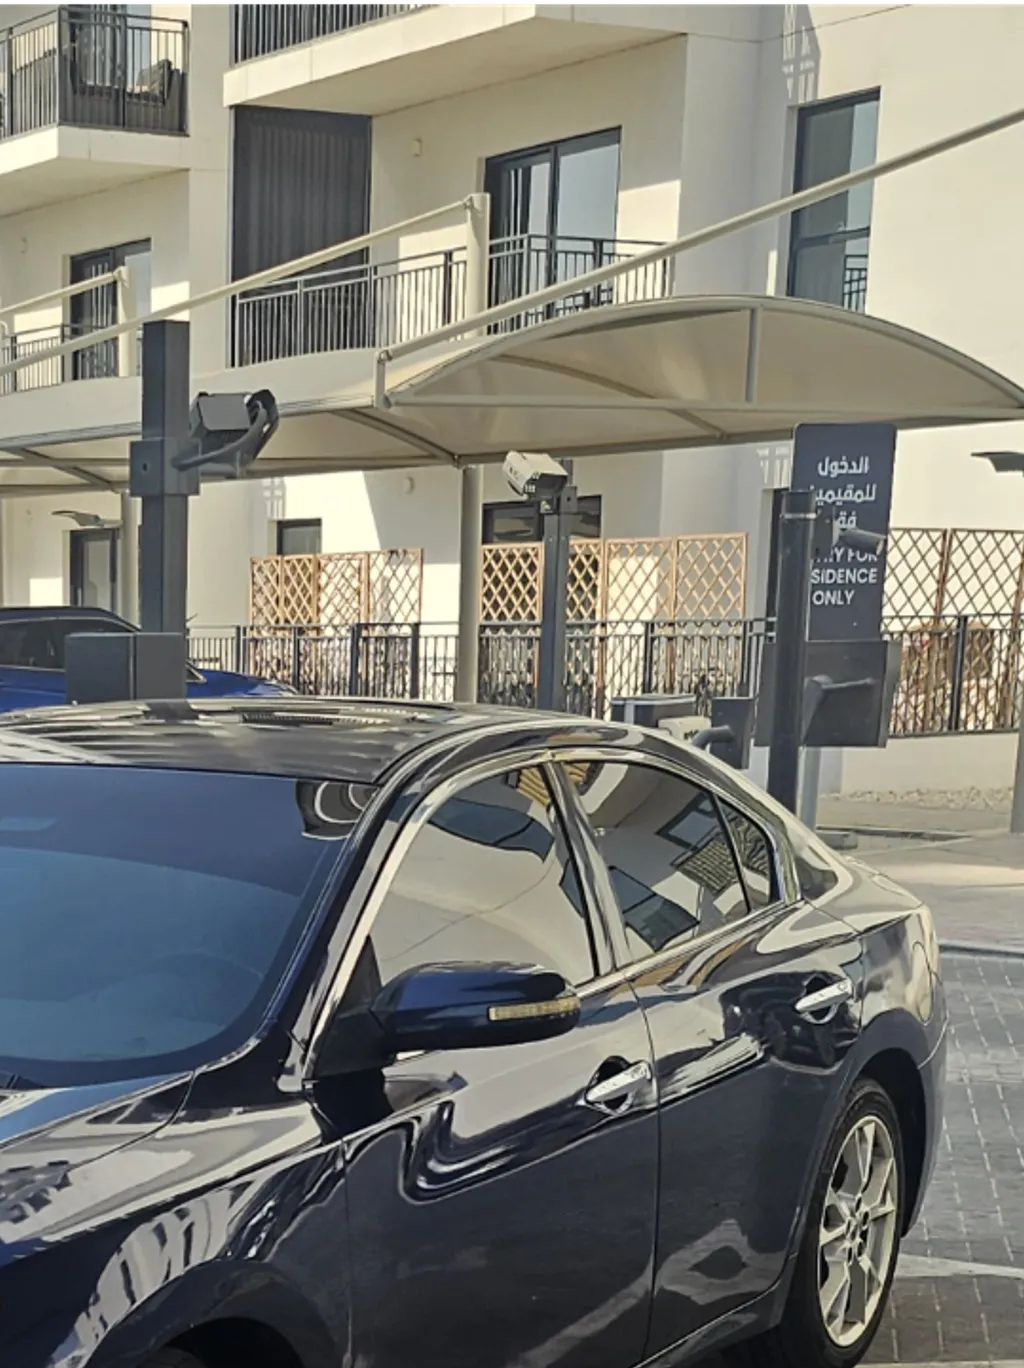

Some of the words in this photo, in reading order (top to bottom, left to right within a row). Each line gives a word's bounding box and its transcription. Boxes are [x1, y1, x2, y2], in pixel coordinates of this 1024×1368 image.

[817, 455, 870, 478] الدخول
[810, 483, 877, 506] للمقيمي
[837, 510, 857, 529] فق
[810, 567, 878, 584] SIDENCE
[812, 589, 855, 606] ONLY
